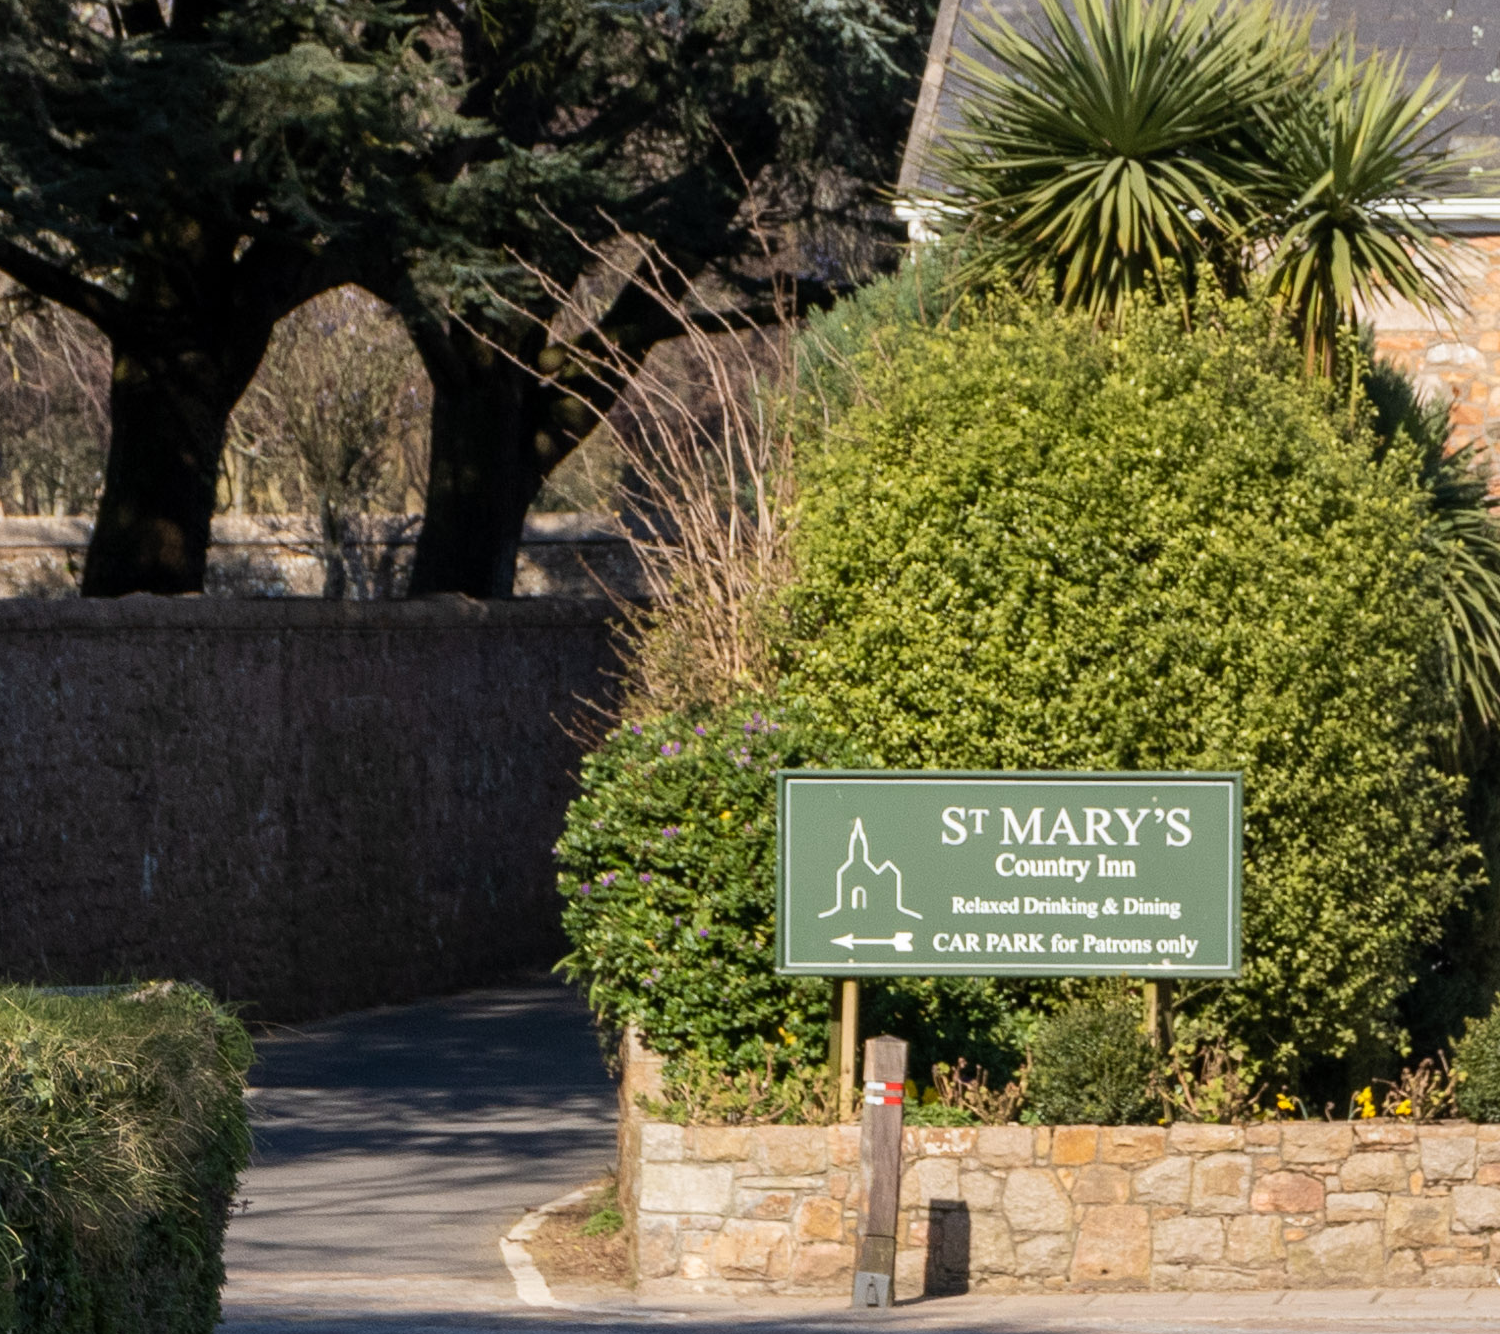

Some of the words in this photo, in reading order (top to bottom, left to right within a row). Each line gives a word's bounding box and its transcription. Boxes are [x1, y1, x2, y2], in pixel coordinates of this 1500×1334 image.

[999, 806, 1193, 847] MARY'S
[995, 853, 1091, 883] Country
[1097, 854, 1136, 877] Inn
[952, 897, 1019, 915] Relaxed
[1023, 897, 1099, 919] Drinking
[1101, 898, 1119, 915] &
[1123, 898, 1182, 920] Dining
[932, 933, 982, 953] CAR
[986, 933, 1046, 953] PARK
[1050, 933, 1079, 953] for
[1082, 934, 1152, 954] Patrons
[1156, 934, 1199, 959] only
